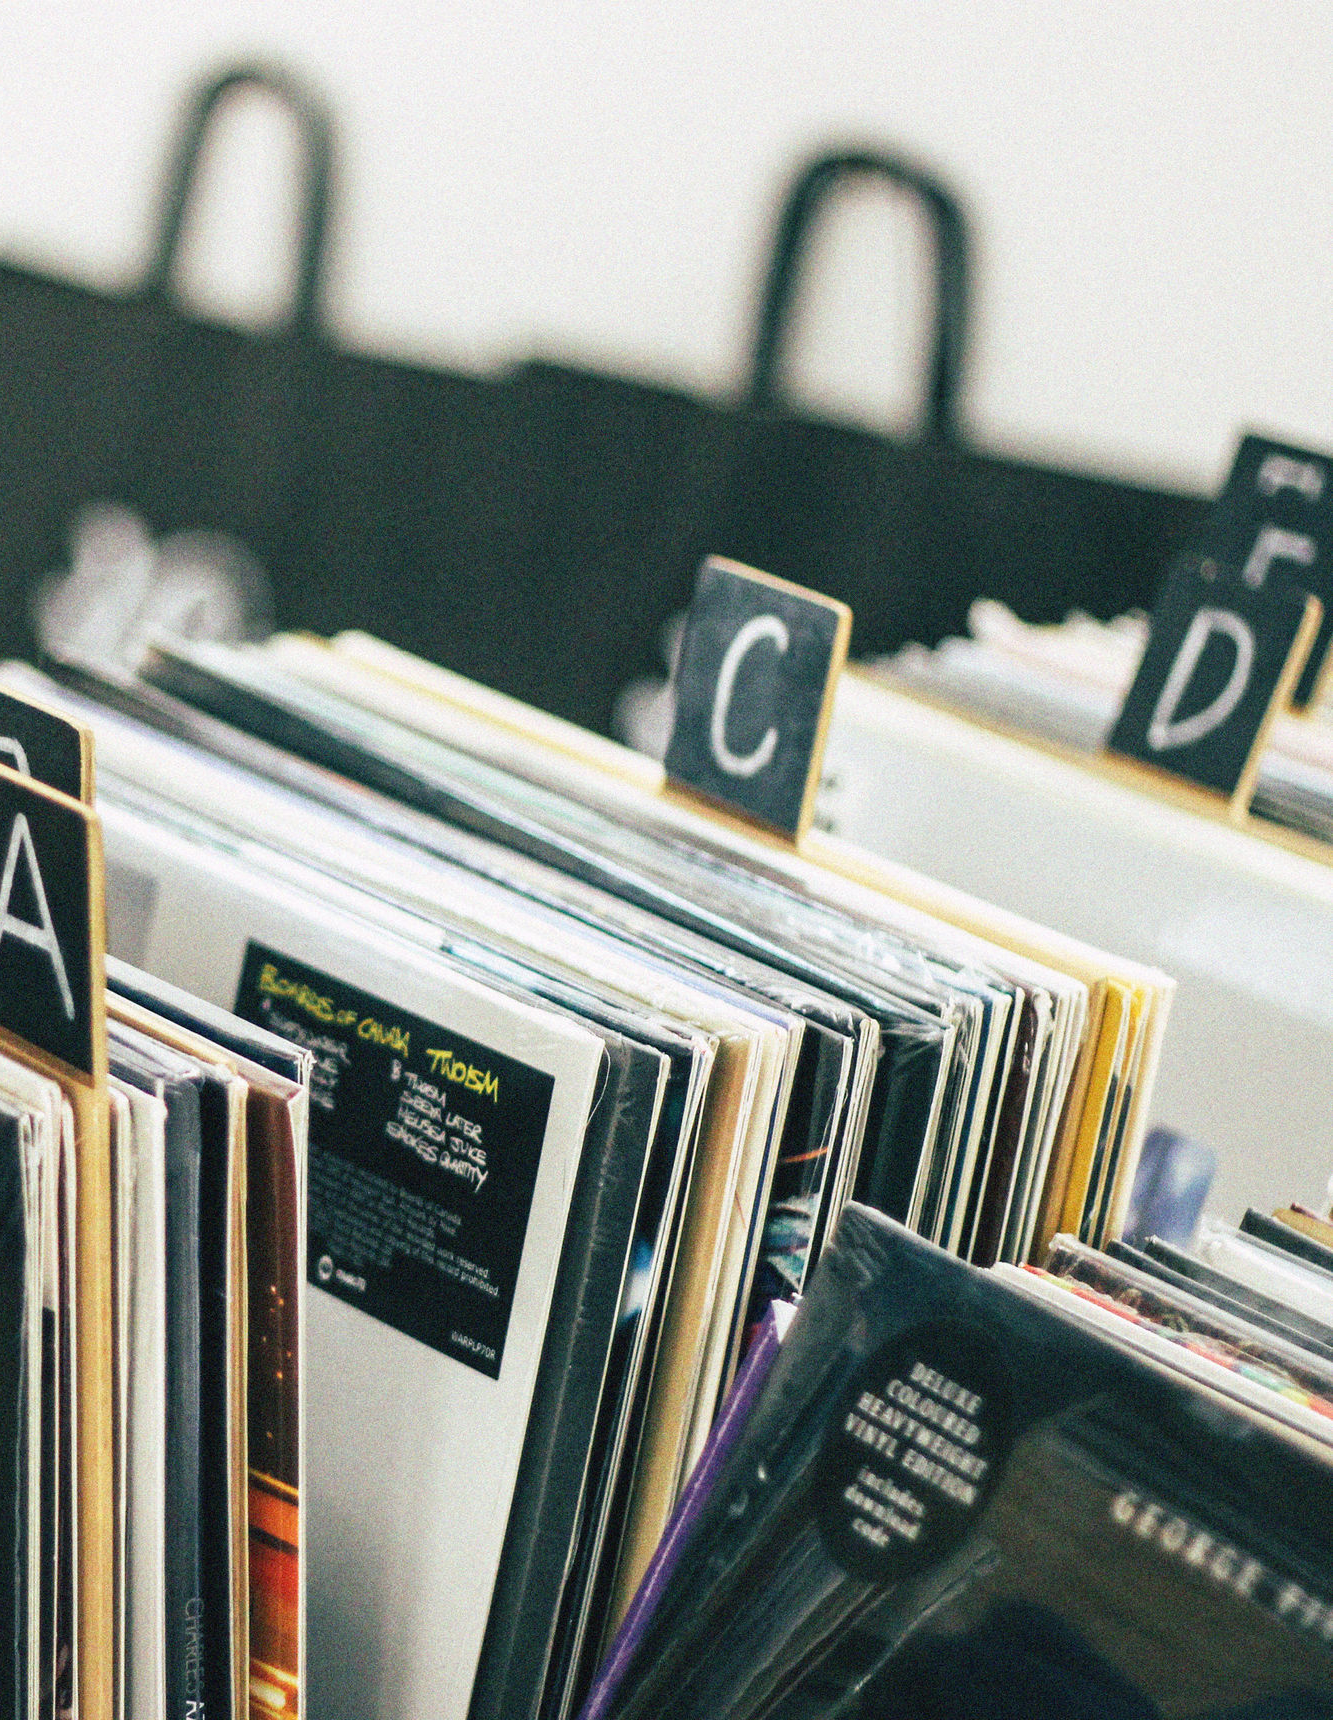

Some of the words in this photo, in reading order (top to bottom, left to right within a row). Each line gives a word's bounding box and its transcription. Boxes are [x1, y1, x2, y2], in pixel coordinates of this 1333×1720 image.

[711, 614, 789, 778] C
[1147, 607, 1255, 750] D
[336, 1010, 358, 1025] OF
[427, 1047, 499, 1103] TWOISM
[445, 1114, 482, 1144] LATER
[450, 1137, 487, 1166] JUICE
[886, 1379, 981, 1445] COLOURED
[912, 1361, 982, 1415] DELUXE
[844, 1412, 899, 1459] VINYL
[901, 1449, 978, 1506] EDITION
[856, 1391, 987, 1479] HEAVYWEIGHT
